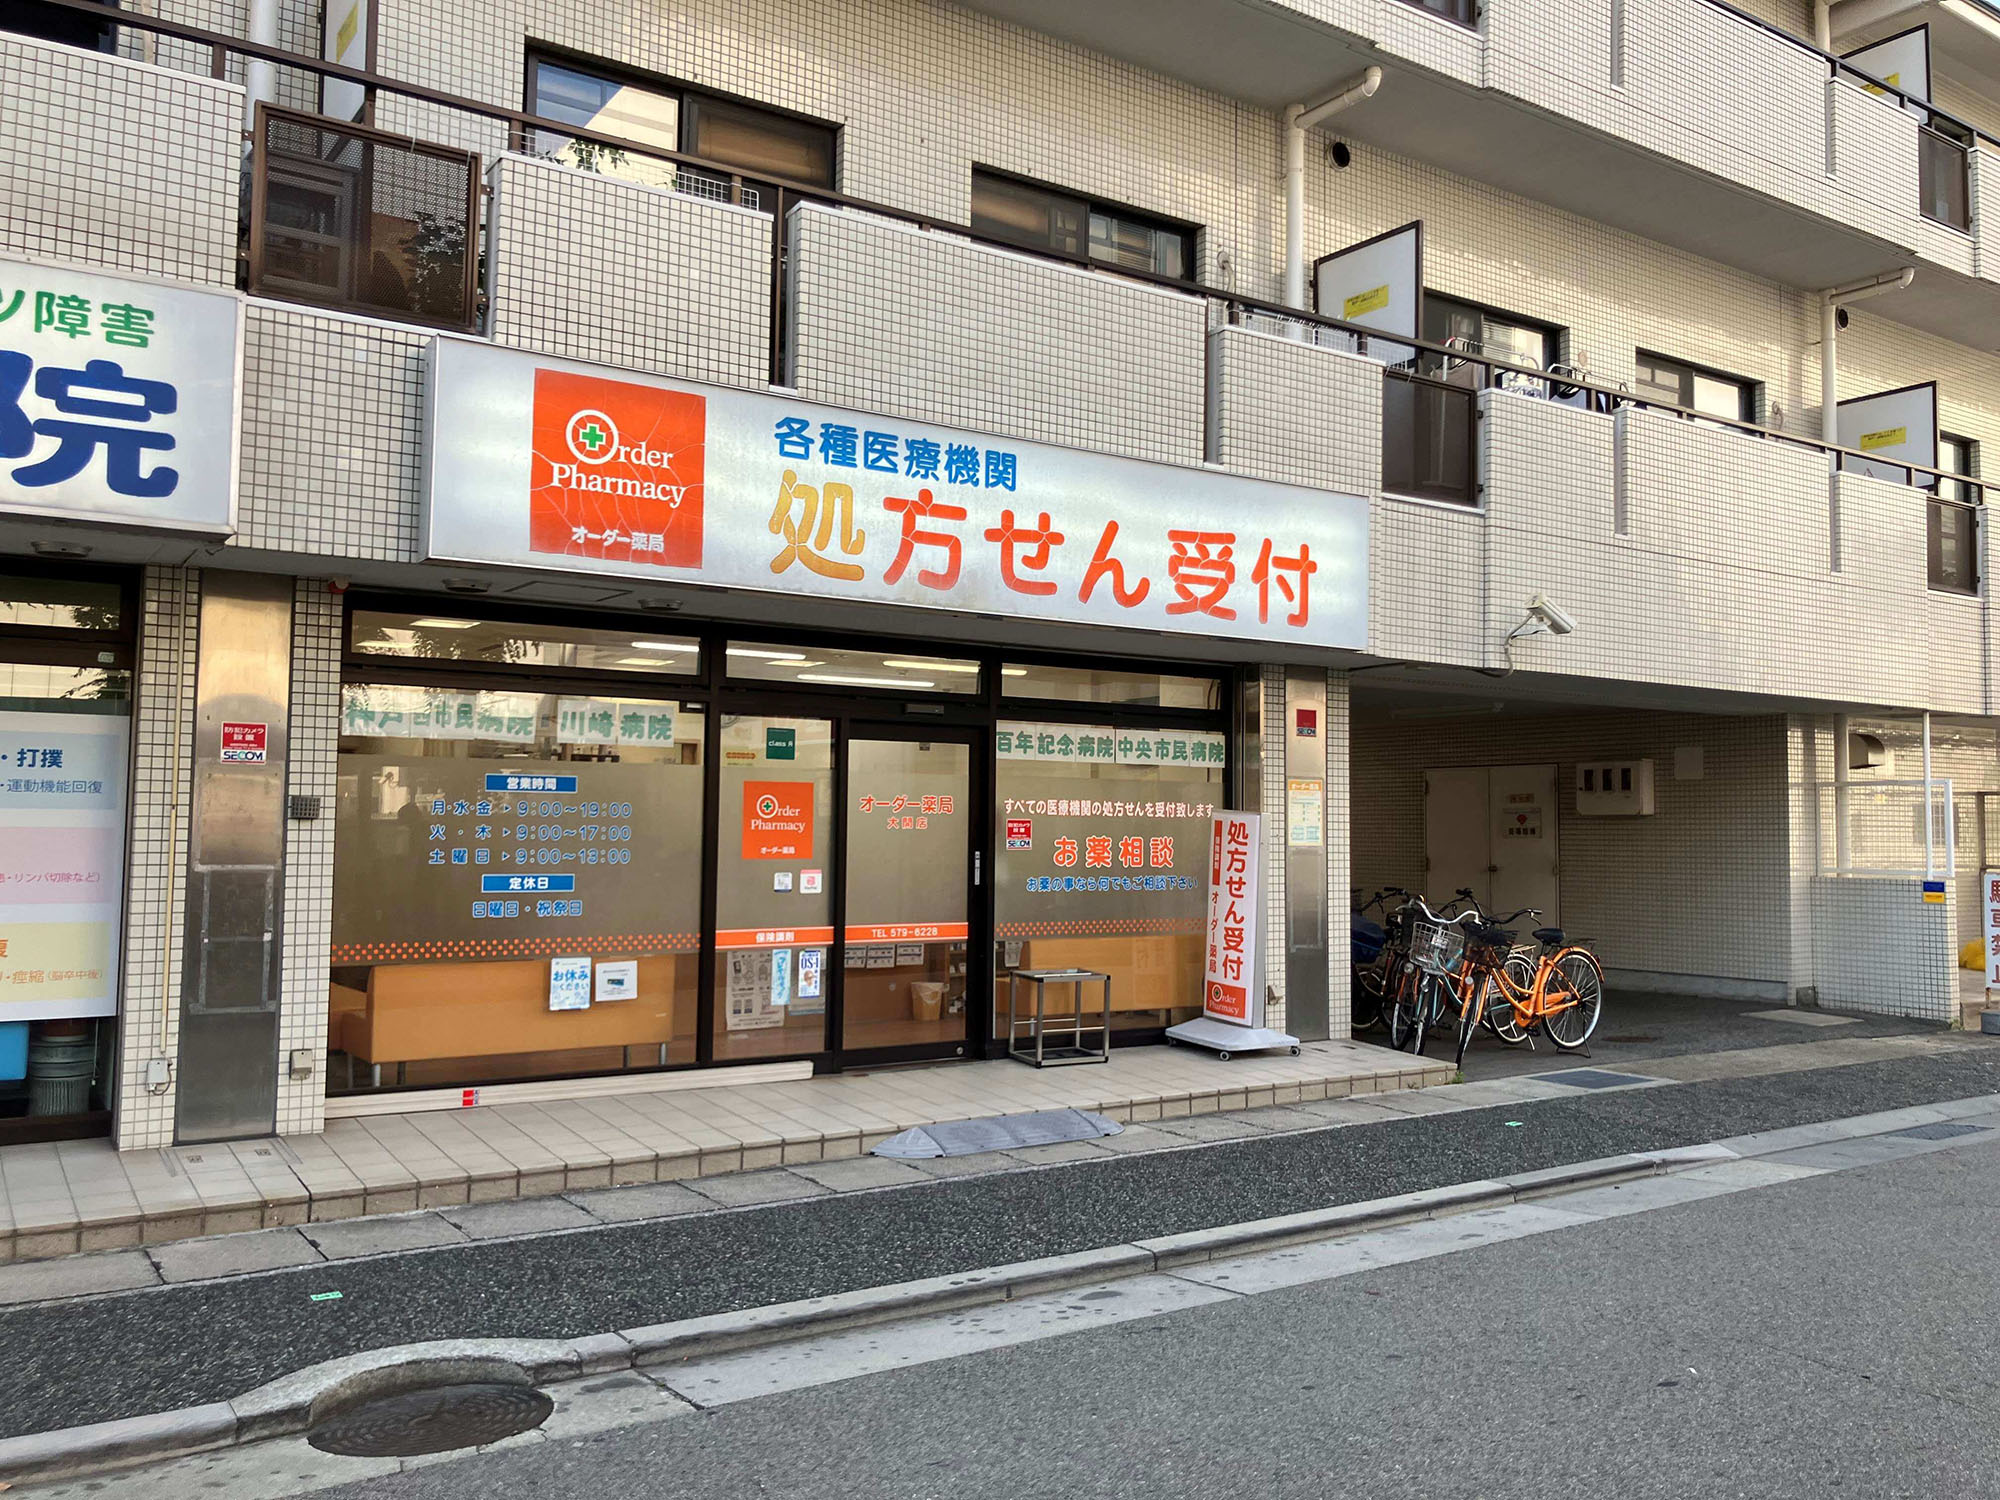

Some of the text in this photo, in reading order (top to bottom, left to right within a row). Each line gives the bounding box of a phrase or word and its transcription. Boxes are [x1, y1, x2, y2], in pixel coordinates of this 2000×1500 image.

[566, 409, 674, 469] Order
[774, 417, 1018, 491] 各種医療機関
[551, 462, 688, 508] Pharmacy
[571, 526, 664, 552] オーダー薬局
[769, 469, 1317, 627] 処方せん受付
[560, 711, 672, 740] 川崎病院
[224, 751, 263, 760] SECOM
[997, 731, 1224, 762] 百年記念病院 中央市民病院
[506, 777, 557, 790] 営業時間
[756, 794, 801, 818] Order
[859, 794, 953, 814] オーダー薬局
[1003, 798, 1214, 818] すべての医療機関の処方せんを受付致します
[750, 818, 806, 833] Pharmacy
[428, 848, 490, 864] 土曜日
[1053, 835, 1174, 868] お薬相談
[509, 877, 549, 890] 定休日
[1026, 875, 1198, 892] お薬の事なら何でもご相談下さい
[472, 900, 582, 918] 日曜日・祝祭日
[1222, 820, 1248, 981] 処方せん受付
[872, 927, 938, 938] TEL 579-6228
[1208, 890, 1219, 973] オーダー薬局
